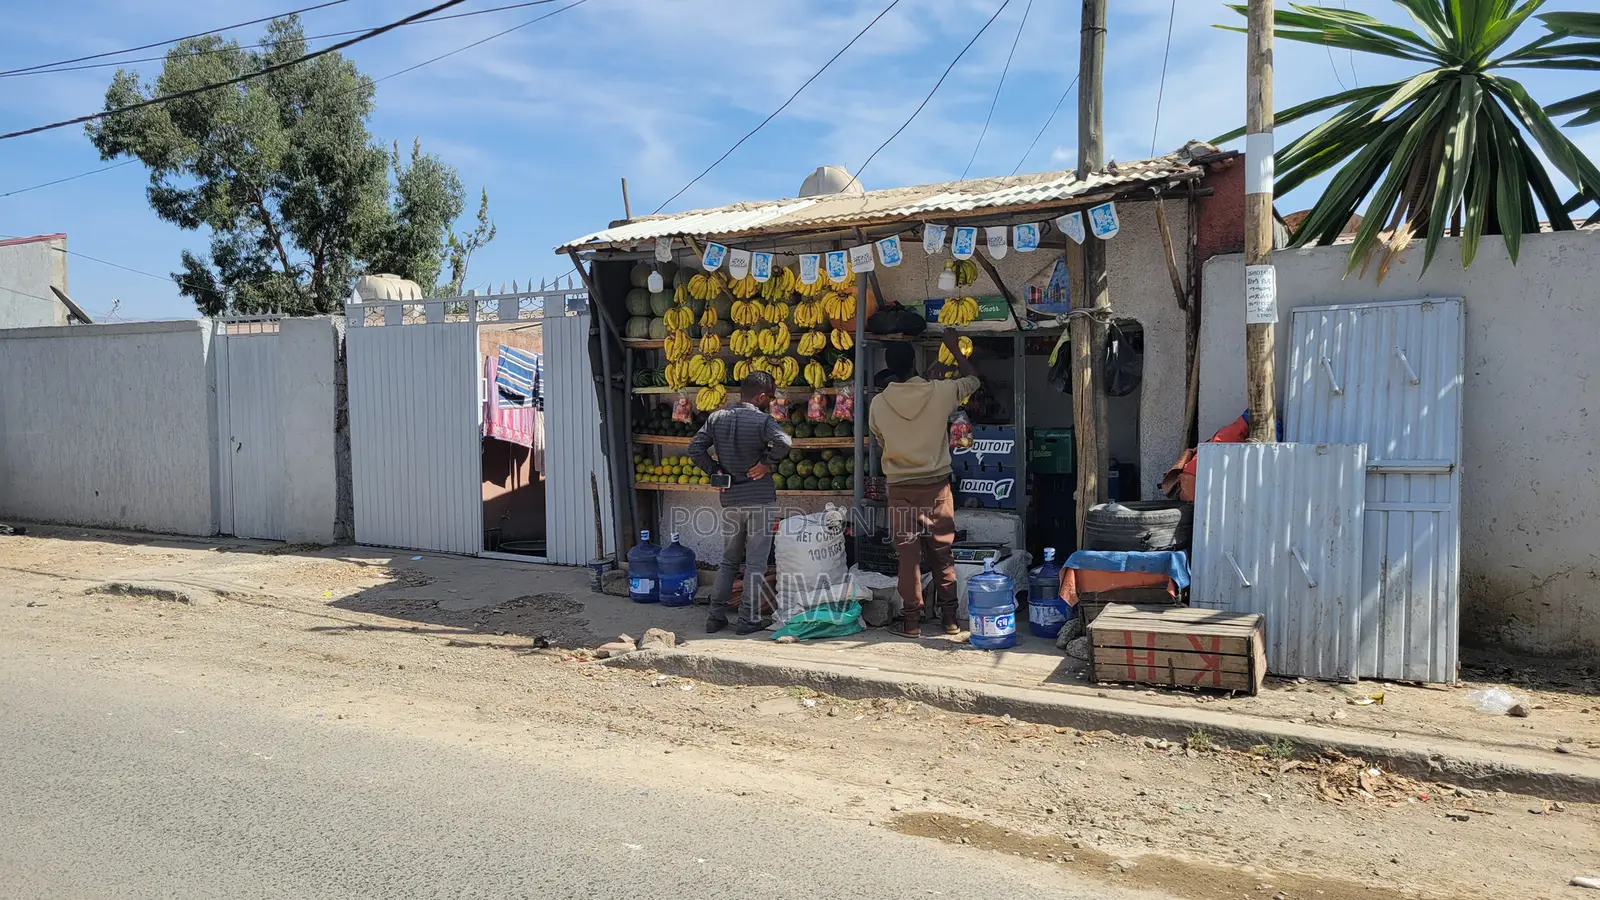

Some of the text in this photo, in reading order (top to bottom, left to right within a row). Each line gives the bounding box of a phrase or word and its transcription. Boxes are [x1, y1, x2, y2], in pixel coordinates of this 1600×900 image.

[978, 304, 1001, 313] Knorr
[972, 441, 1013, 452] DUTOIT
[959, 480, 994, 493] DUTOI
